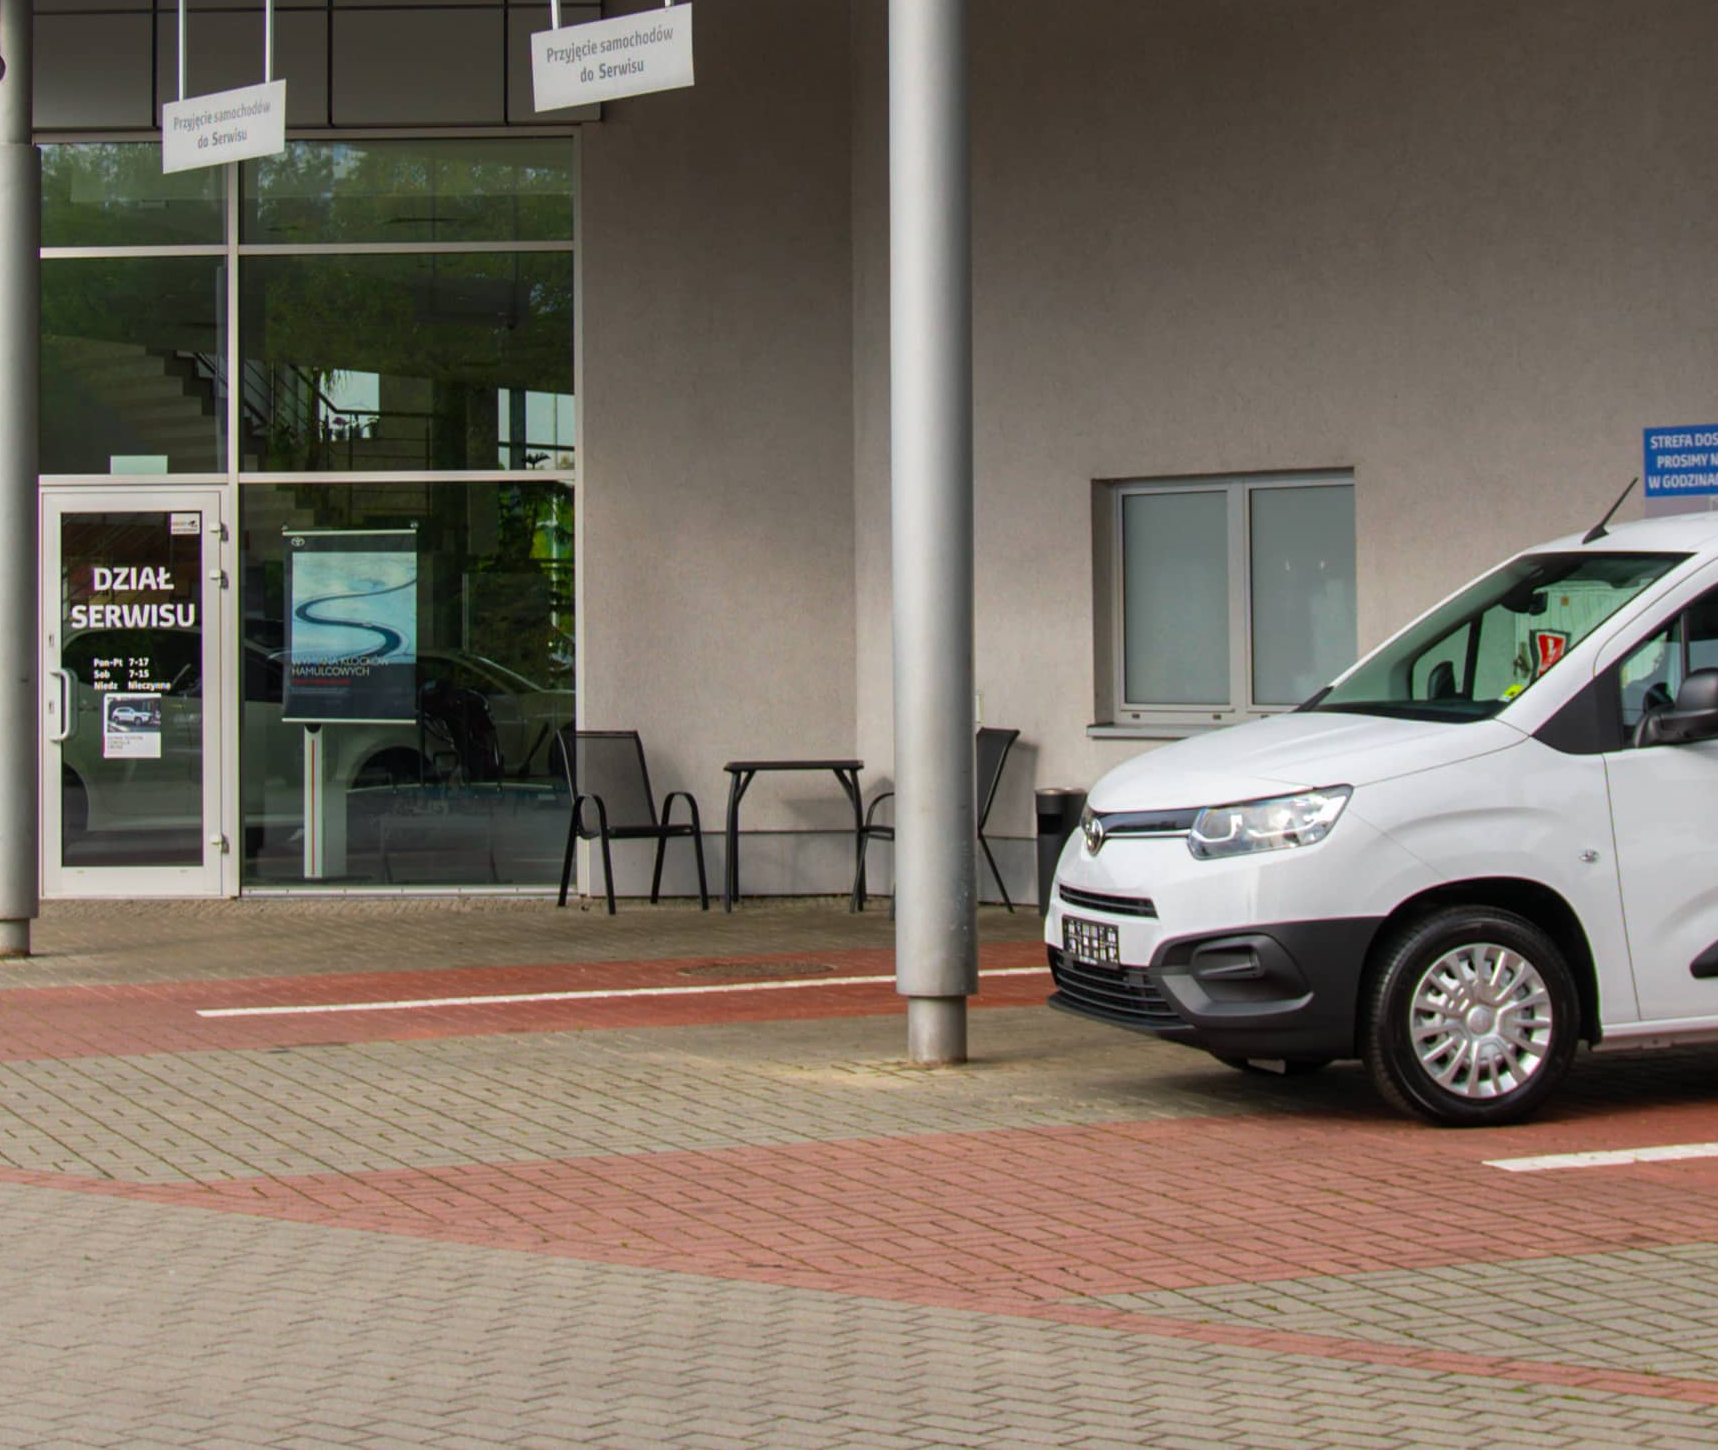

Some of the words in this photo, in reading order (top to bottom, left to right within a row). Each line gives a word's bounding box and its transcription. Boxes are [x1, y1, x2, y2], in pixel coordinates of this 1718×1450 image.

[546, 39, 598, 64] Przyjęcie
[600, 25, 674, 53] samochodów
[580, 67, 594, 83] do
[599, 58, 645, 79] Serwisu
[173, 111, 213, 132] Przyjęcie
[213, 99, 271, 123] samochodów
[197, 134, 209, 149] do
[212, 127, 248, 146] Serwisu
[1650, 434, 1693, 449] STREFA
[1657, 453, 1709, 469] PROSIMY
[1649, 475, 1661, 489] W
[92, 566, 175, 591] DZIAŁ
[70, 603, 195, 629] SERWISU
[93, 657, 123, 668] Pon-Pt
[129, 657, 149, 667] 7-17
[93, 669, 111, 679] Sob
[291, 666, 370, 677] HAMULCOWYCH
[93, 681, 118, 690] Niedz
